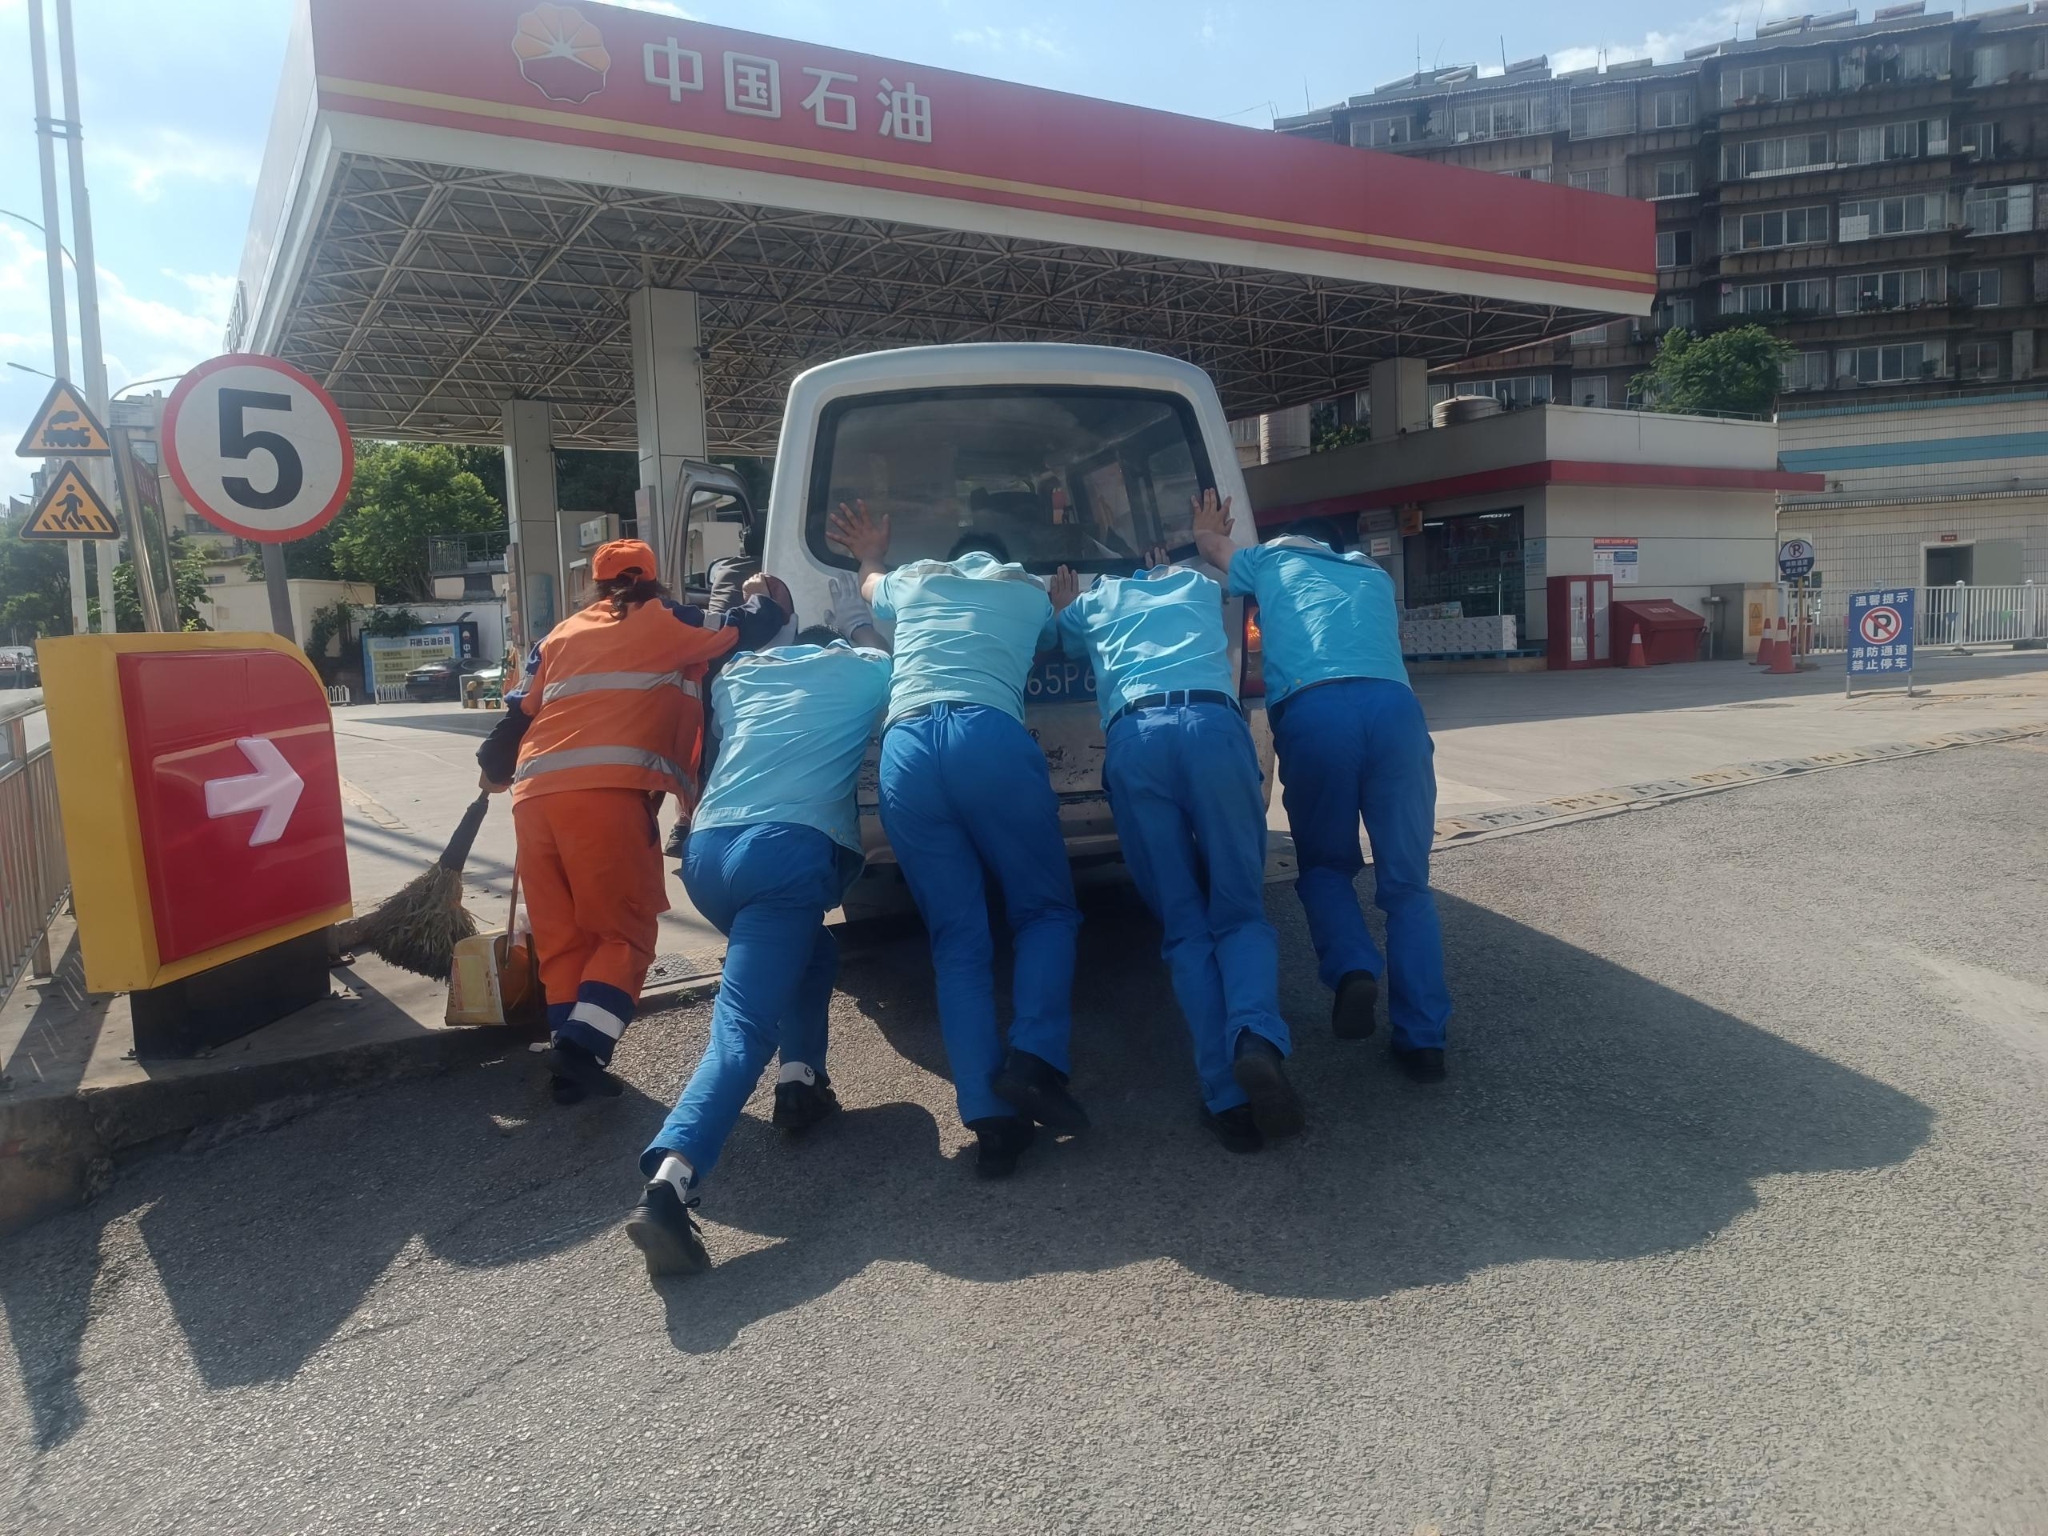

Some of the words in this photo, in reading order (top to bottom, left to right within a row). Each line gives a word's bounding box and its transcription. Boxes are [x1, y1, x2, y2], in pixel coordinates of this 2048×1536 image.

[643, 36, 932, 142] 中国石油
[218, 387, 303, 510] 5
[1855, 592, 1908, 607] 温馨提示
[1852, 644, 1907, 658] 消防通道
[1852, 657, 1907, 671] 禁止停车
